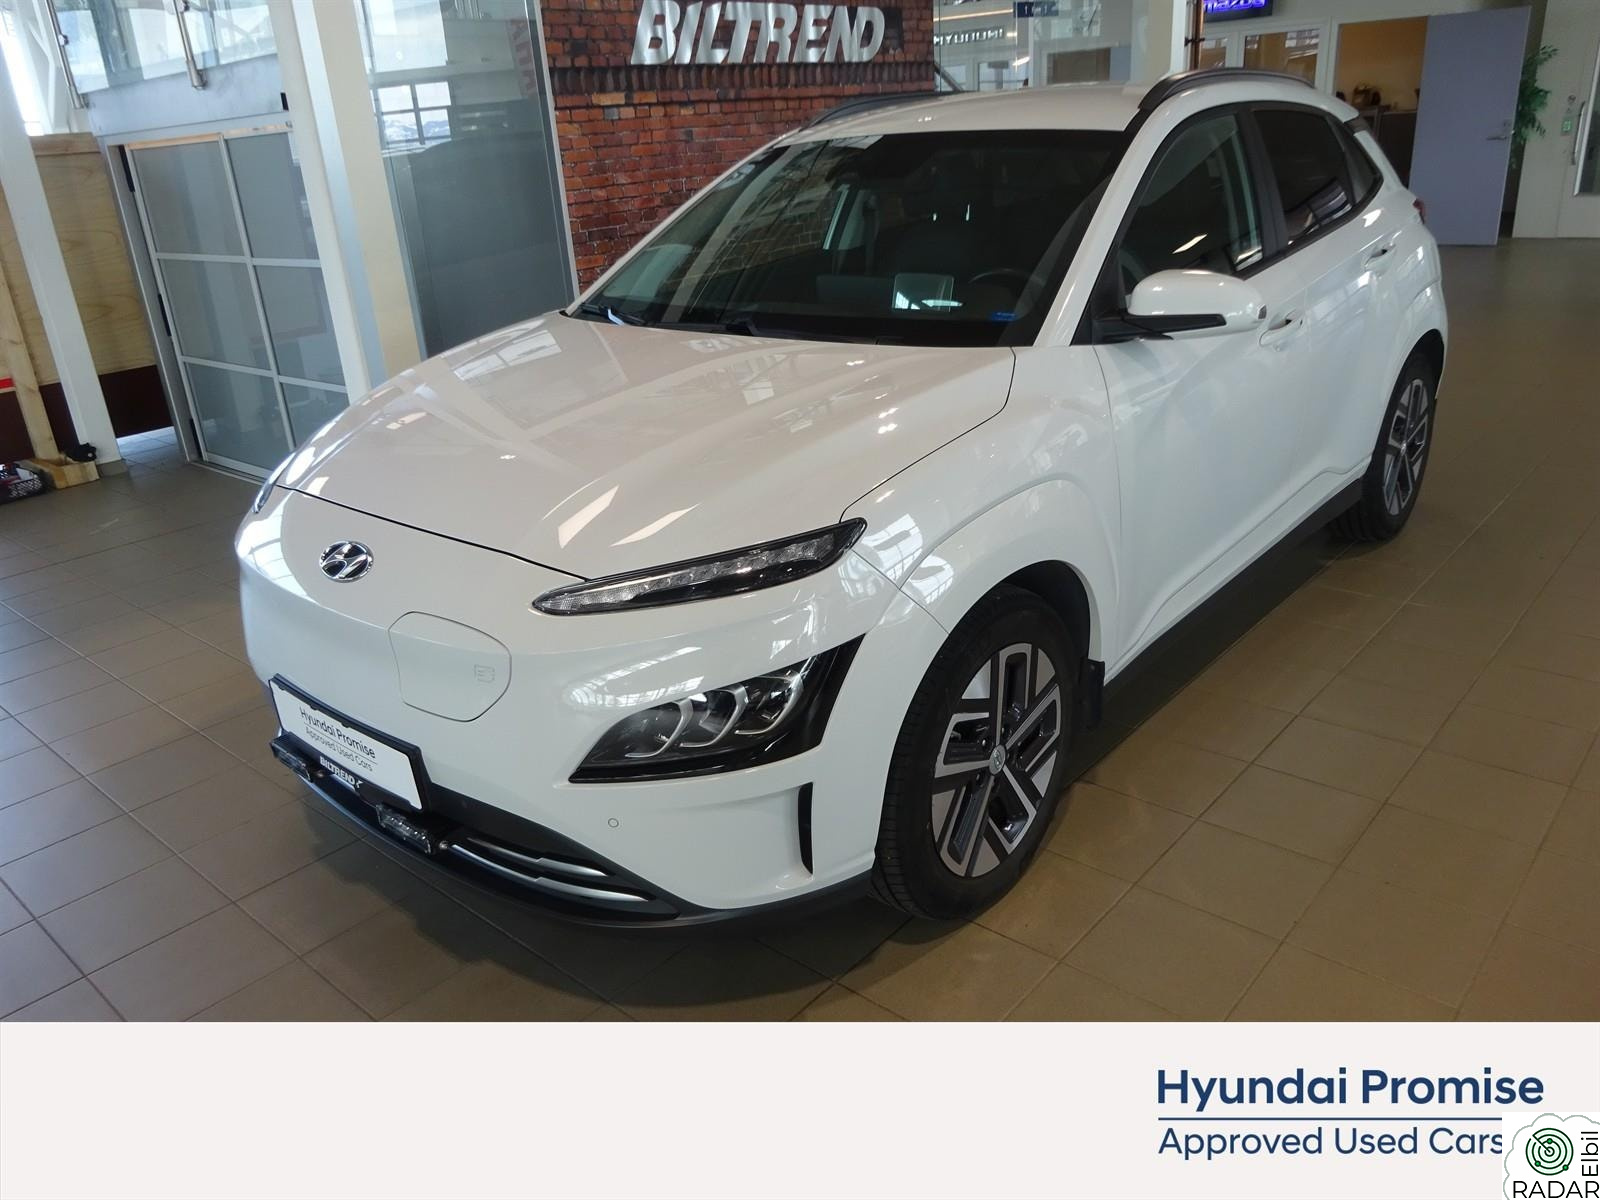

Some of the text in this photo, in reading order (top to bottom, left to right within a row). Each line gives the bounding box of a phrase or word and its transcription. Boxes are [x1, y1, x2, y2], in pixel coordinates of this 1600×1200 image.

[630, 0, 885, 65] BILTREND
[300, 706, 376, 759] Hyundai Promise
[306, 727, 373, 772] Approved Used Cars
[320, 756, 355, 785] BILTREND
